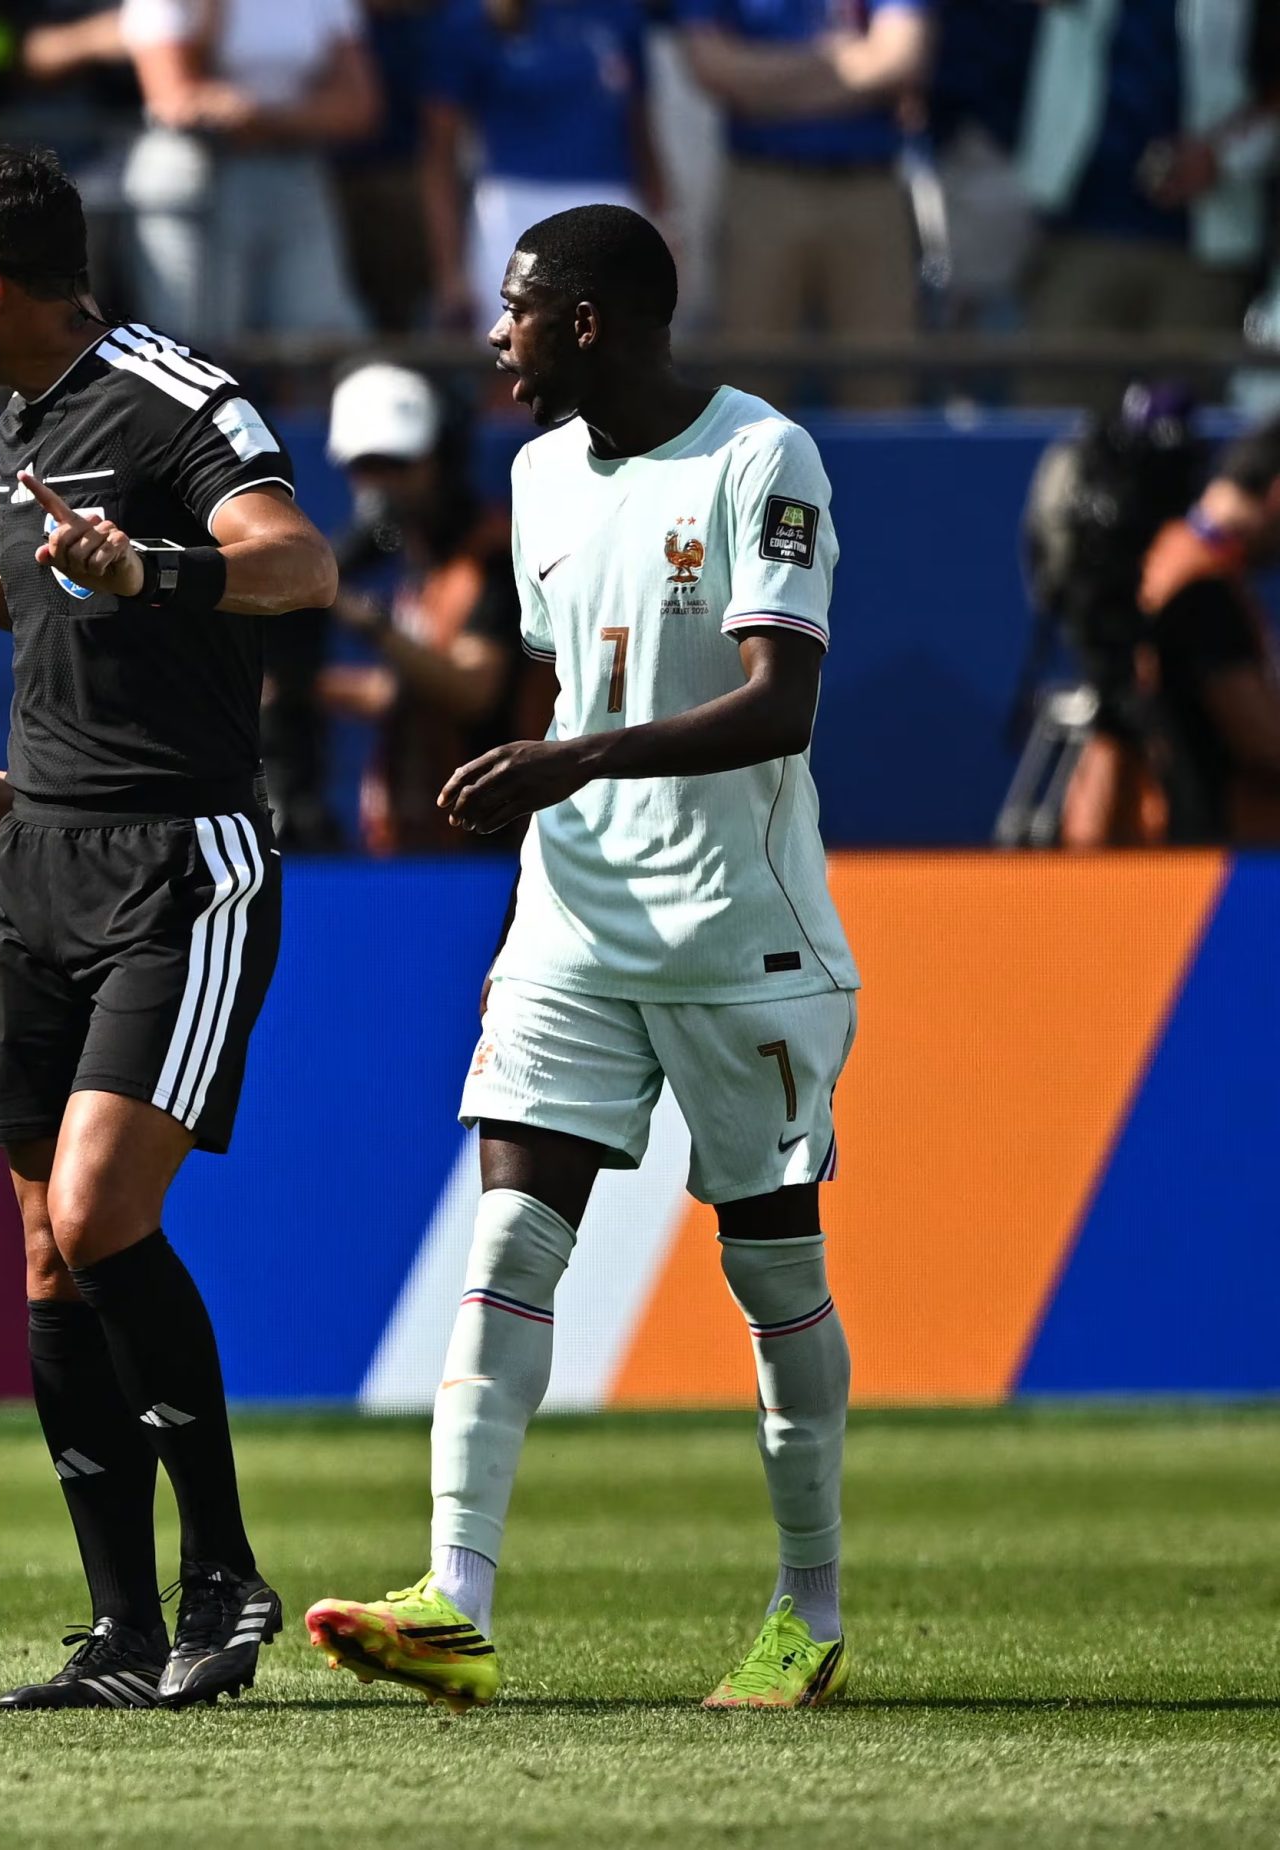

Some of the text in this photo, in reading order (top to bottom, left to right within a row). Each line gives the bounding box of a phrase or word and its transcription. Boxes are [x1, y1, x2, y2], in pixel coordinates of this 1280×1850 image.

[769, 537, 807, 554] EDUCATION
[600, 626, 630, 714] 7
[756, 1039, 797, 1122] 7
